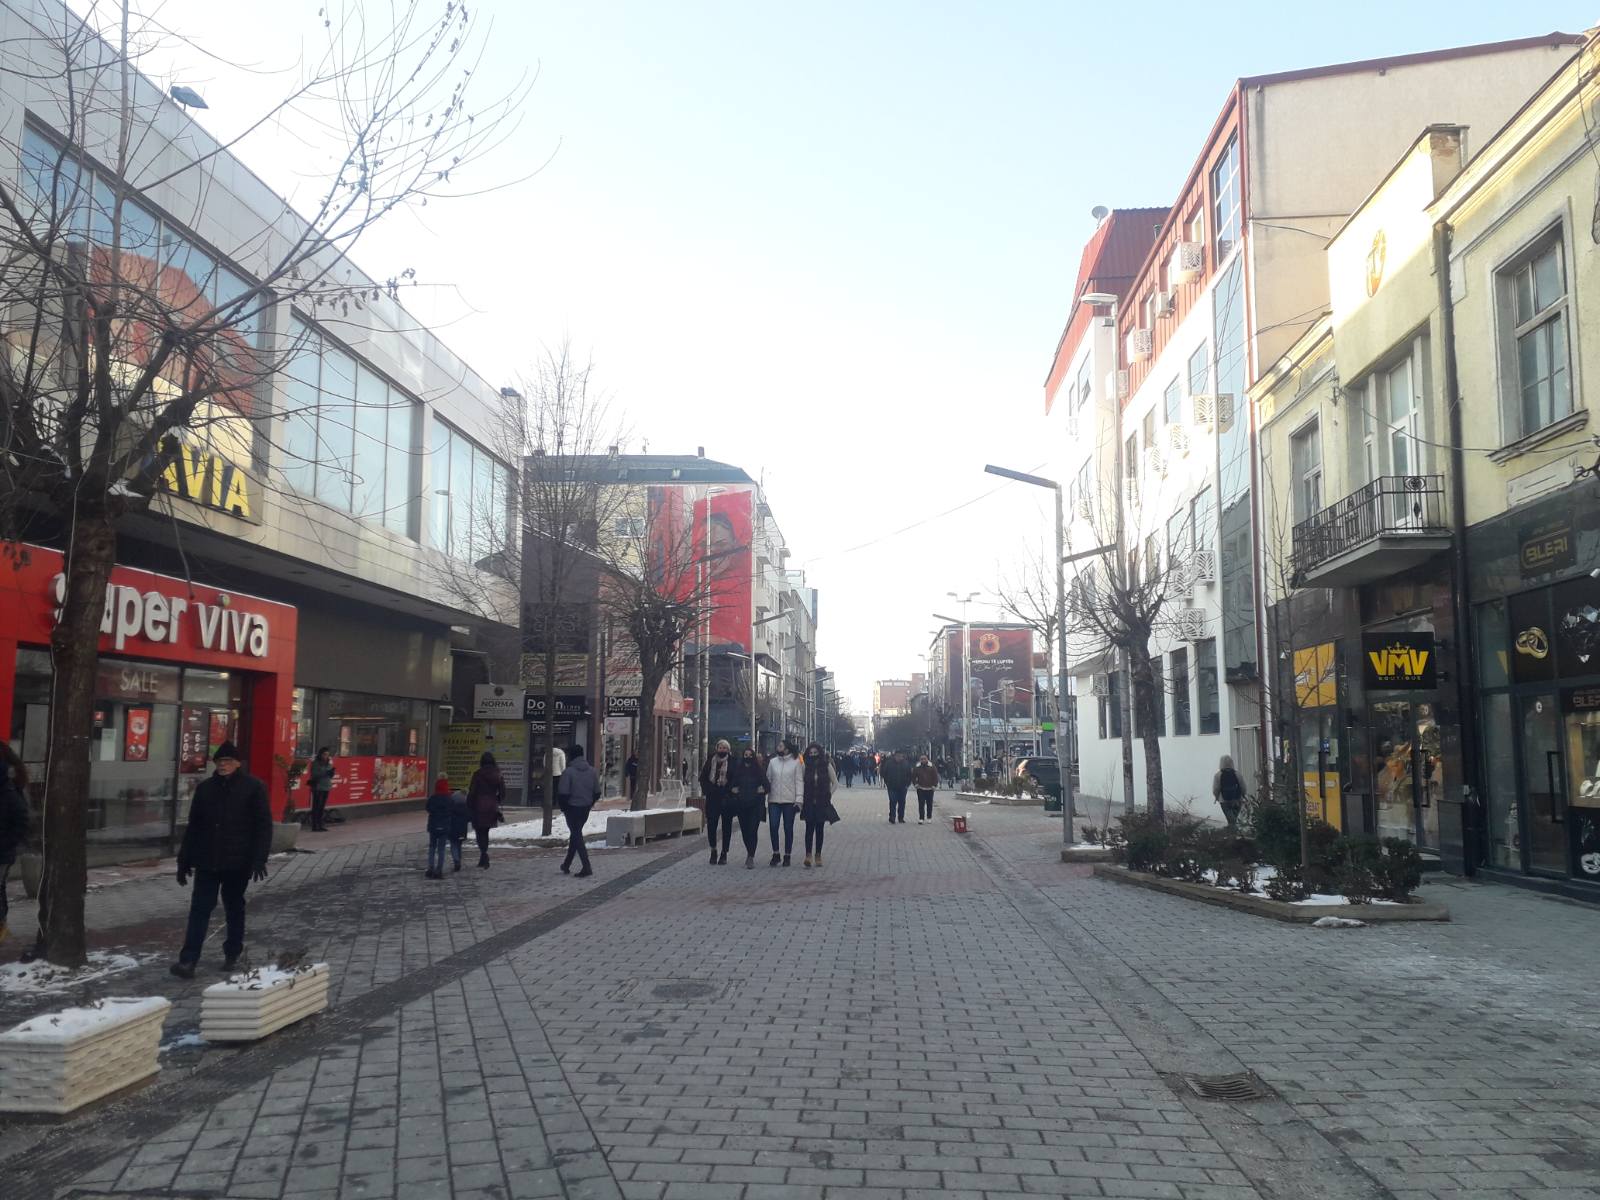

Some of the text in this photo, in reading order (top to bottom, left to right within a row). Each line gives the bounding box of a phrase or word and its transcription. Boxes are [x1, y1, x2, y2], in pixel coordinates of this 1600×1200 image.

[192, 594, 269, 657] viva
[1368, 648, 1429, 676] VMV
[119, 668, 159, 693] SALE
[481, 700, 515, 708] NORMA
[527, 698, 563, 710] Don
[609, 697, 637, 707] Doen
